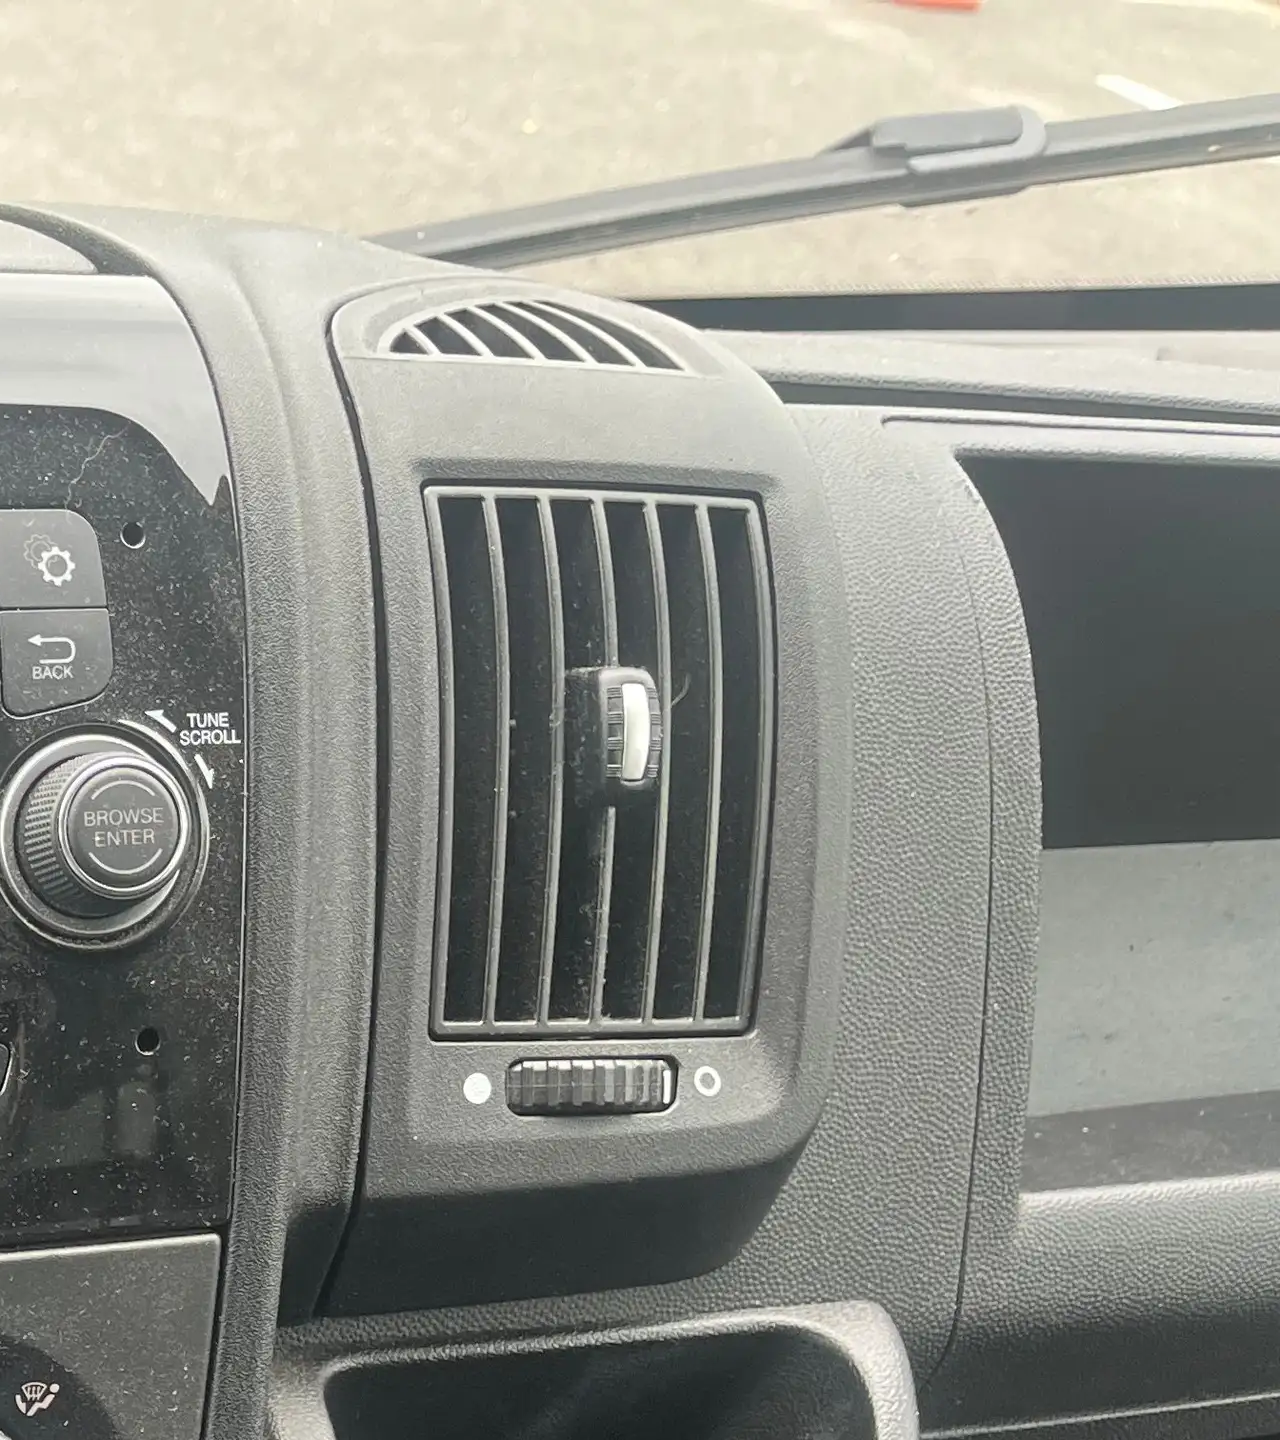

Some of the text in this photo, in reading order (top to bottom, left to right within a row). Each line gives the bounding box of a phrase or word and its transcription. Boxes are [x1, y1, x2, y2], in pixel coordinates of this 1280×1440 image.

[32, 665, 74, 681] BACK
[186, 712, 230, 728] TUNE
[179, 728, 241, 746] SCROLL
[83, 808, 165, 828] BROWSE
[94, 828, 156, 848] ENTER
